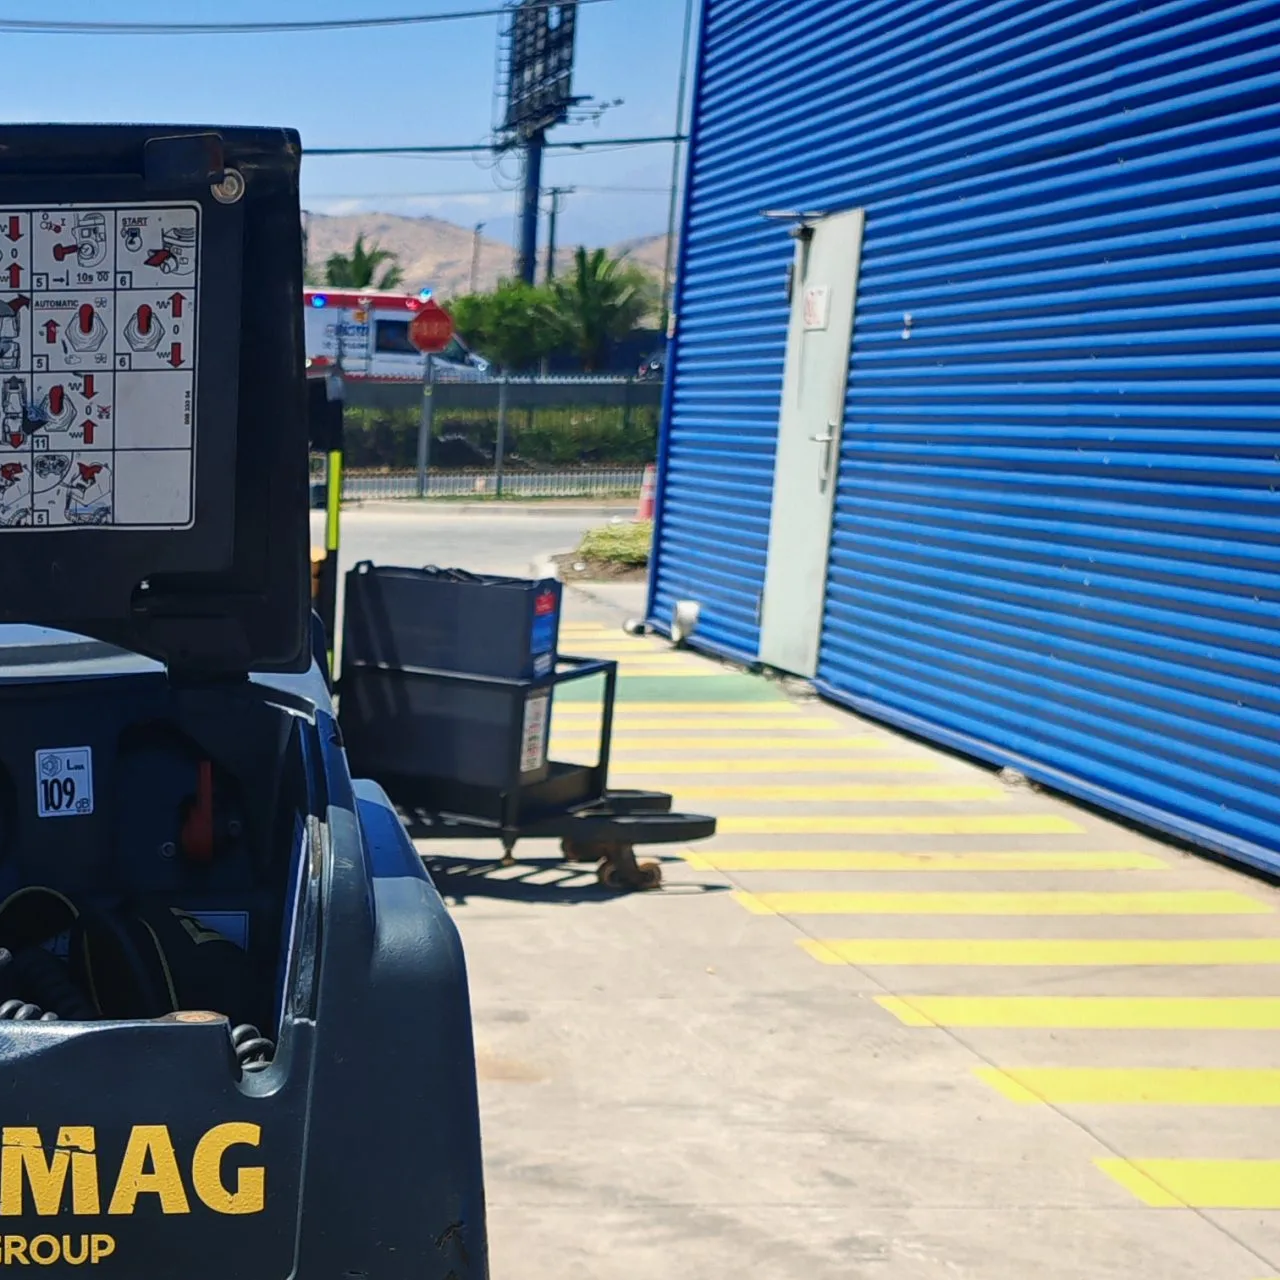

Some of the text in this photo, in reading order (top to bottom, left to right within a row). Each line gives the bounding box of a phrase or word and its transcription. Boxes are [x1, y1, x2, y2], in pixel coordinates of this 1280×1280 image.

[122, 217, 148, 226] START
[36, 277, 43, 288] 5
[76, 273, 94, 282] 10s
[120, 276, 127, 286] 6
[34, 299, 79, 308] AUTOMATIC
[36, 358, 43, 368] 5
[119, 356, 127, 367] 6
[34, 439, 46, 448] 11
[37, 513, 44, 523] 5
[41, 777, 75, 811] 109
